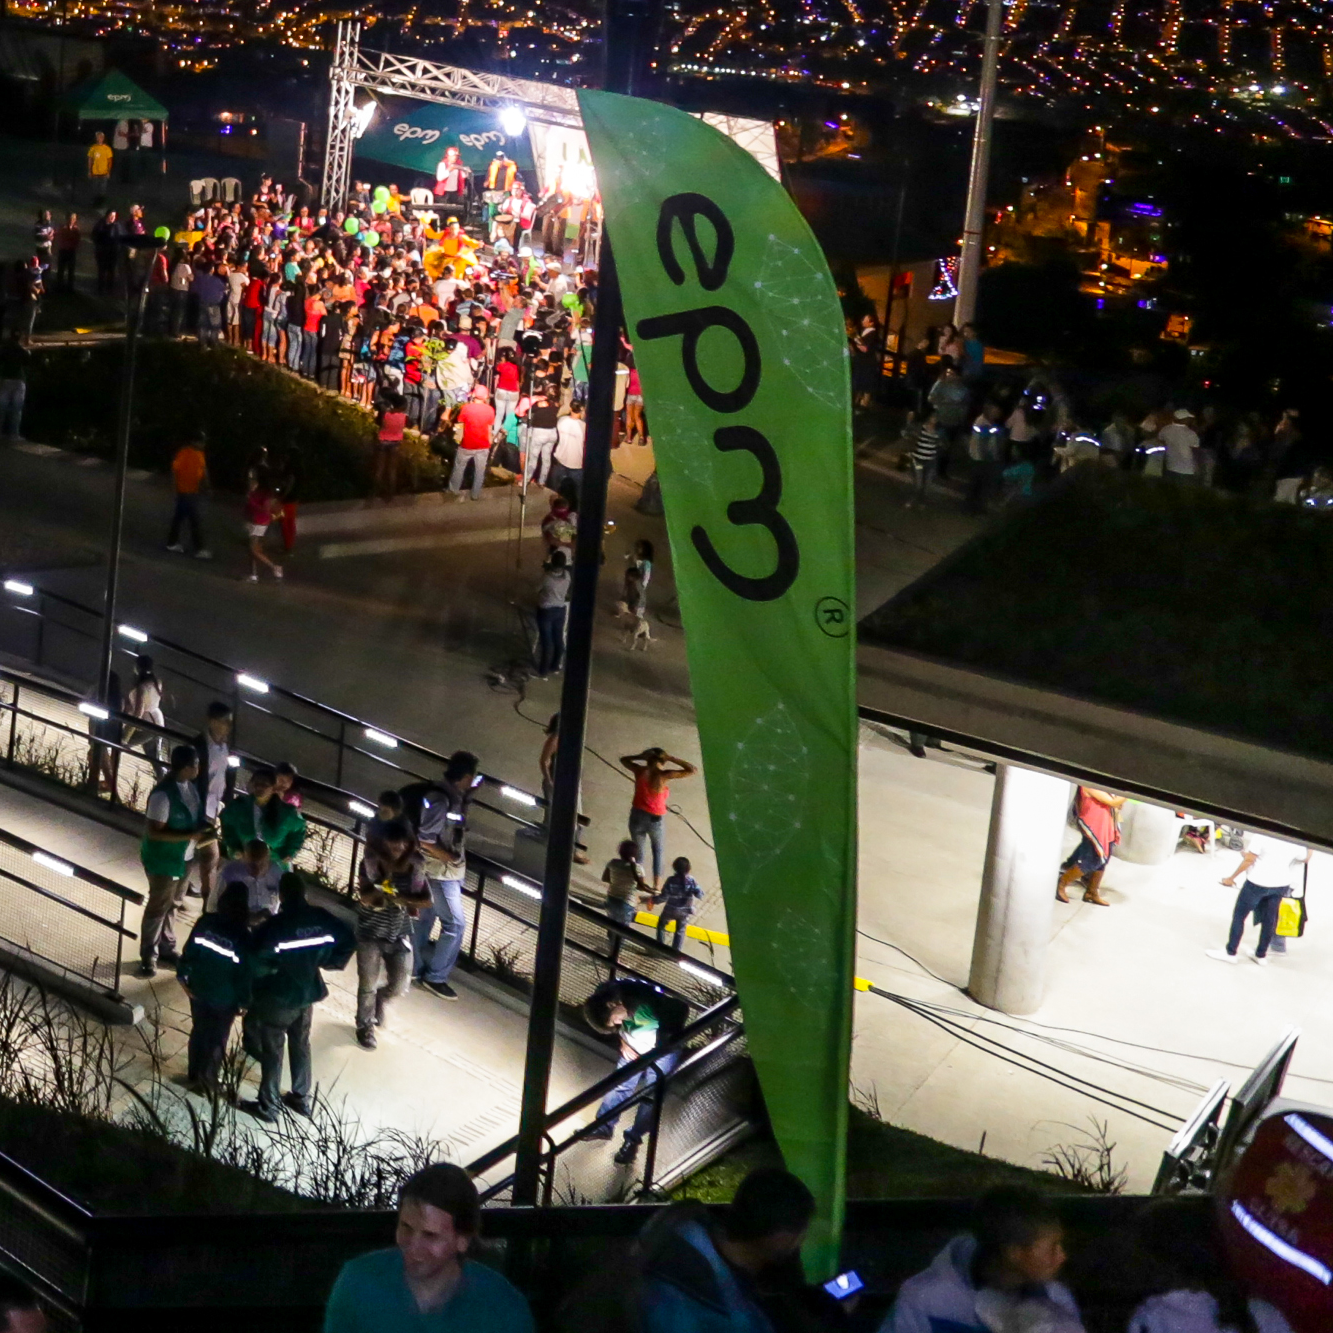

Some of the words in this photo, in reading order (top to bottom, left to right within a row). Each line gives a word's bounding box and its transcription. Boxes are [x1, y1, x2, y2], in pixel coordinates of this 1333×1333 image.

[106, 93, 132, 103] epm
[394, 122, 440, 145] epm
[459, 130, 506, 151] epm
[637, 192, 800, 602] epm
